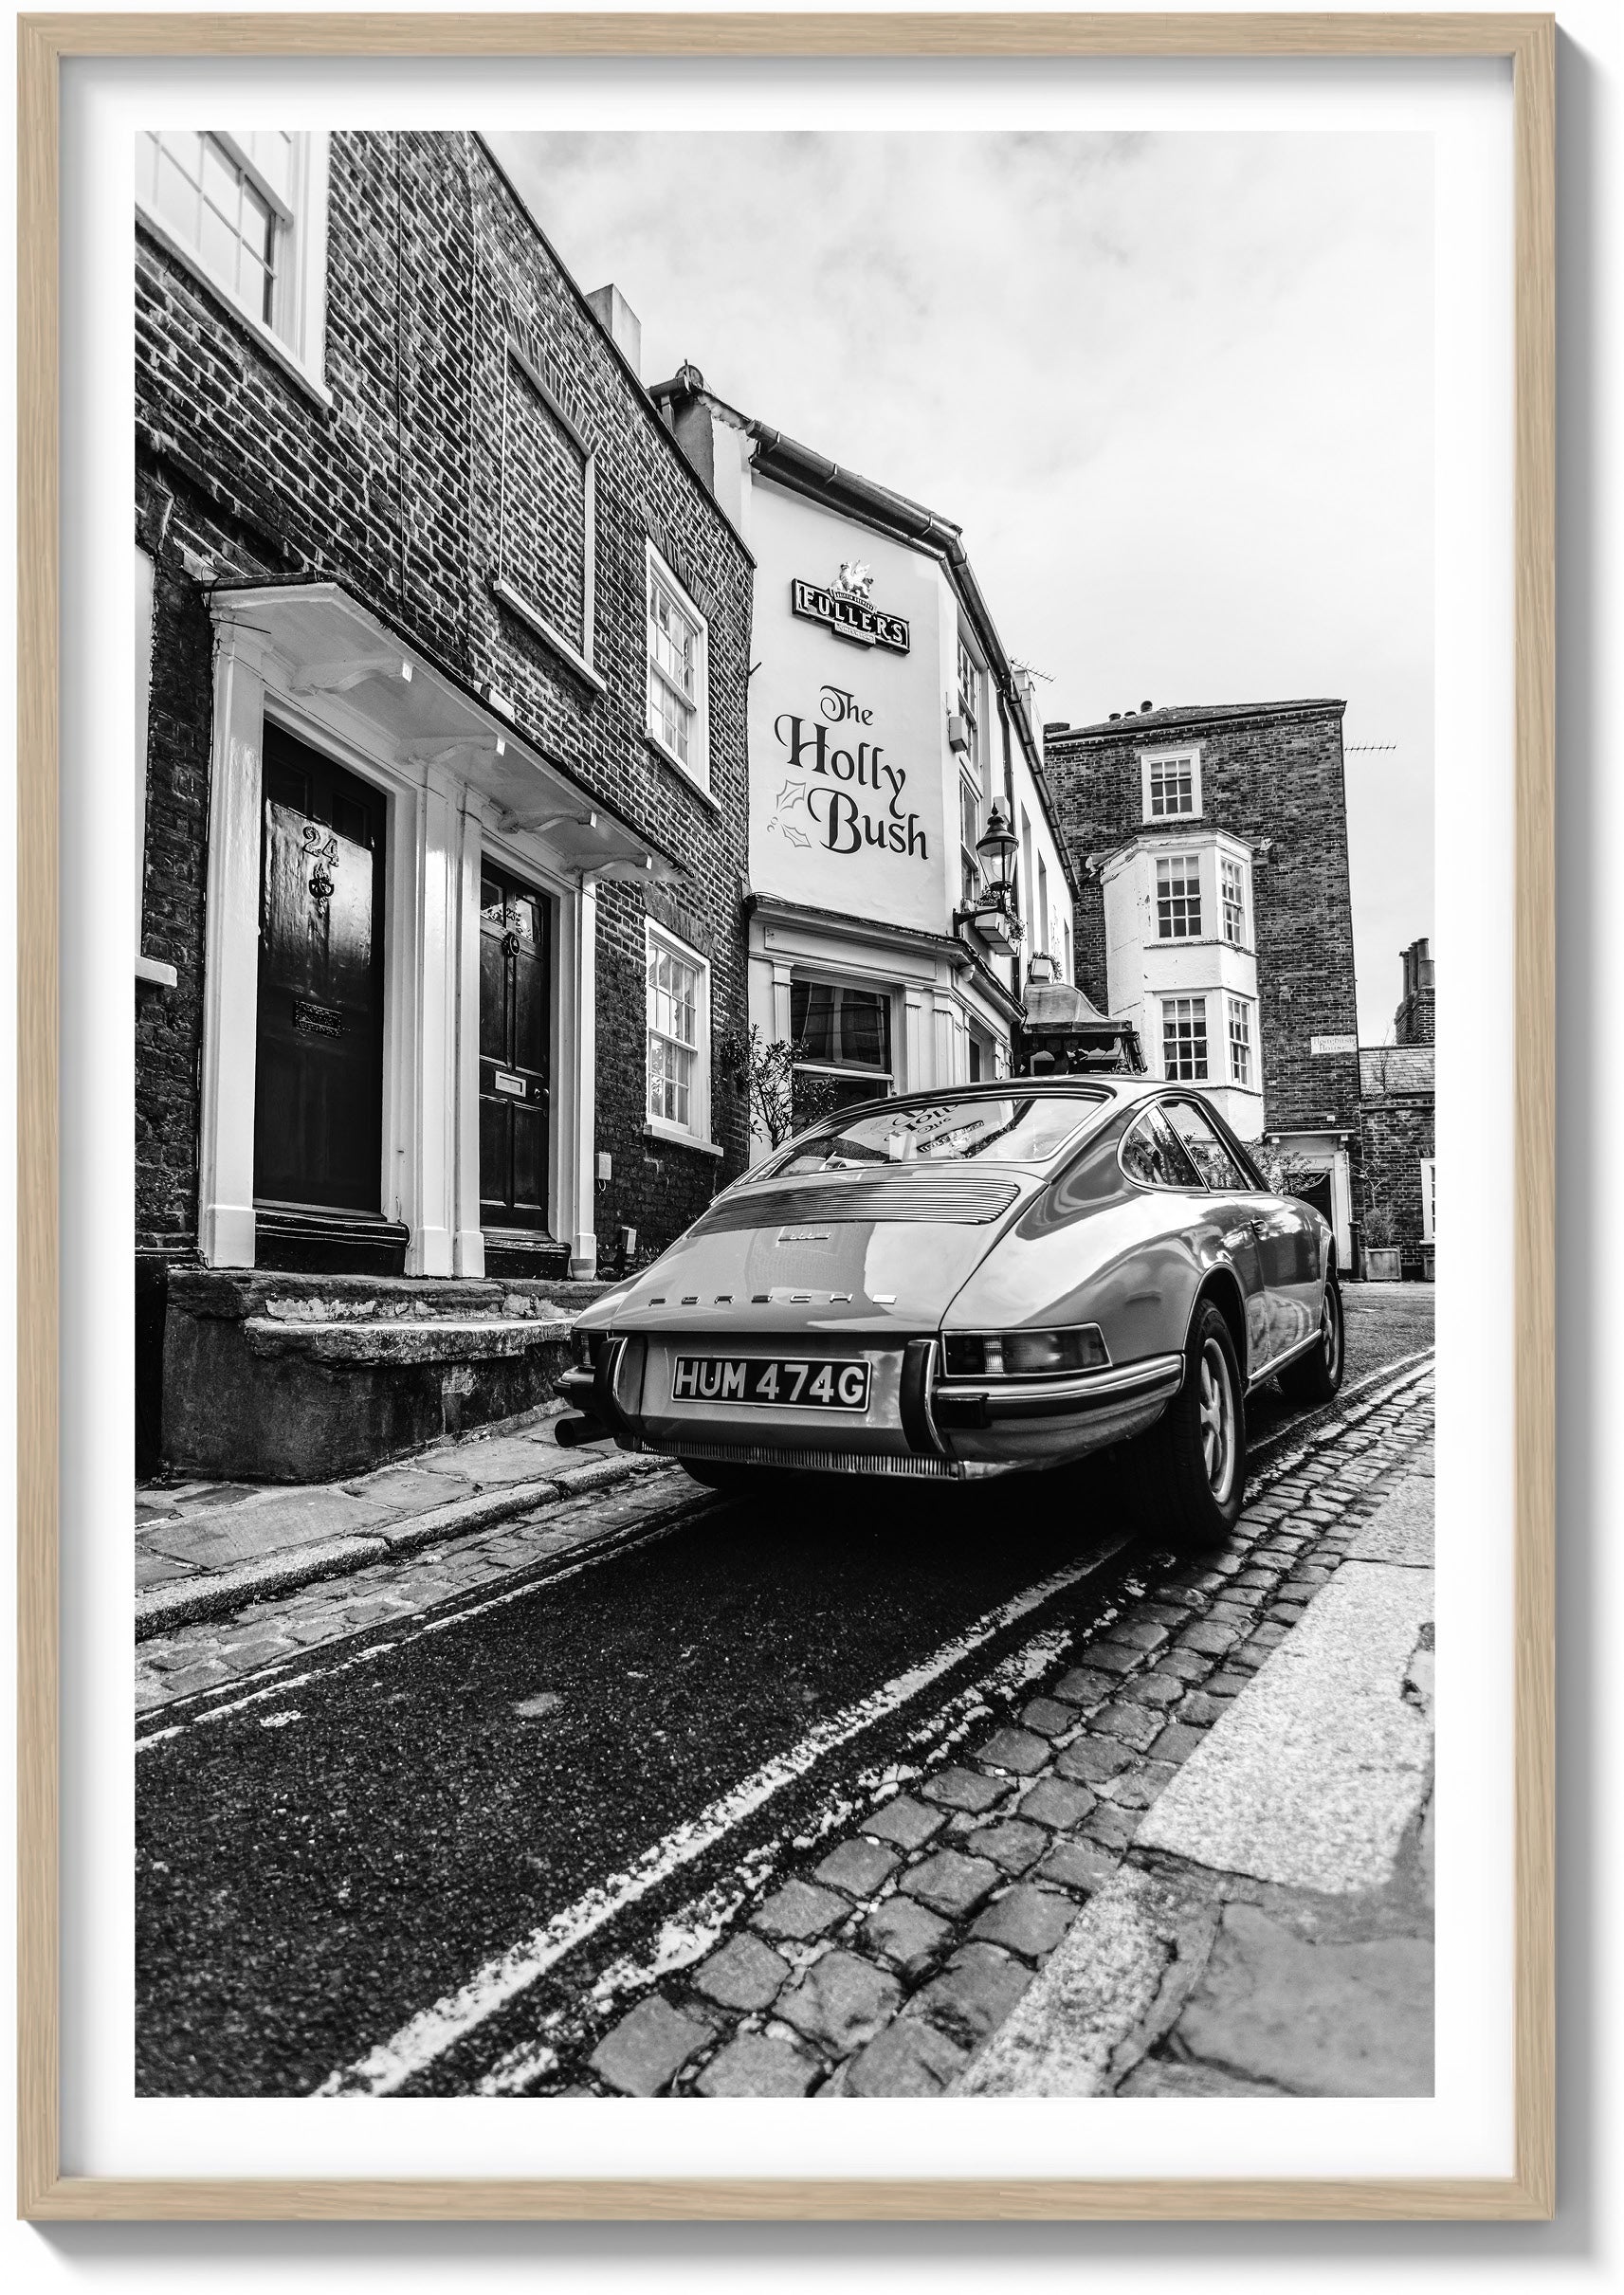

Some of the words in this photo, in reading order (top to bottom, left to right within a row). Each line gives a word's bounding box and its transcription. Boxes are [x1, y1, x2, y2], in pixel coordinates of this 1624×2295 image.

[803, 585, 903, 644] FULLER'S
[819, 684, 874, 726] The
[773, 714, 907, 820] Holly
[301, 825, 339, 868] 24
[807, 787, 929, 860] Bush
[648, 1293, 898, 1307] PORSCHE
[674, 1360, 747, 1399] HUM
[756, 1362, 866, 1406] 474G
